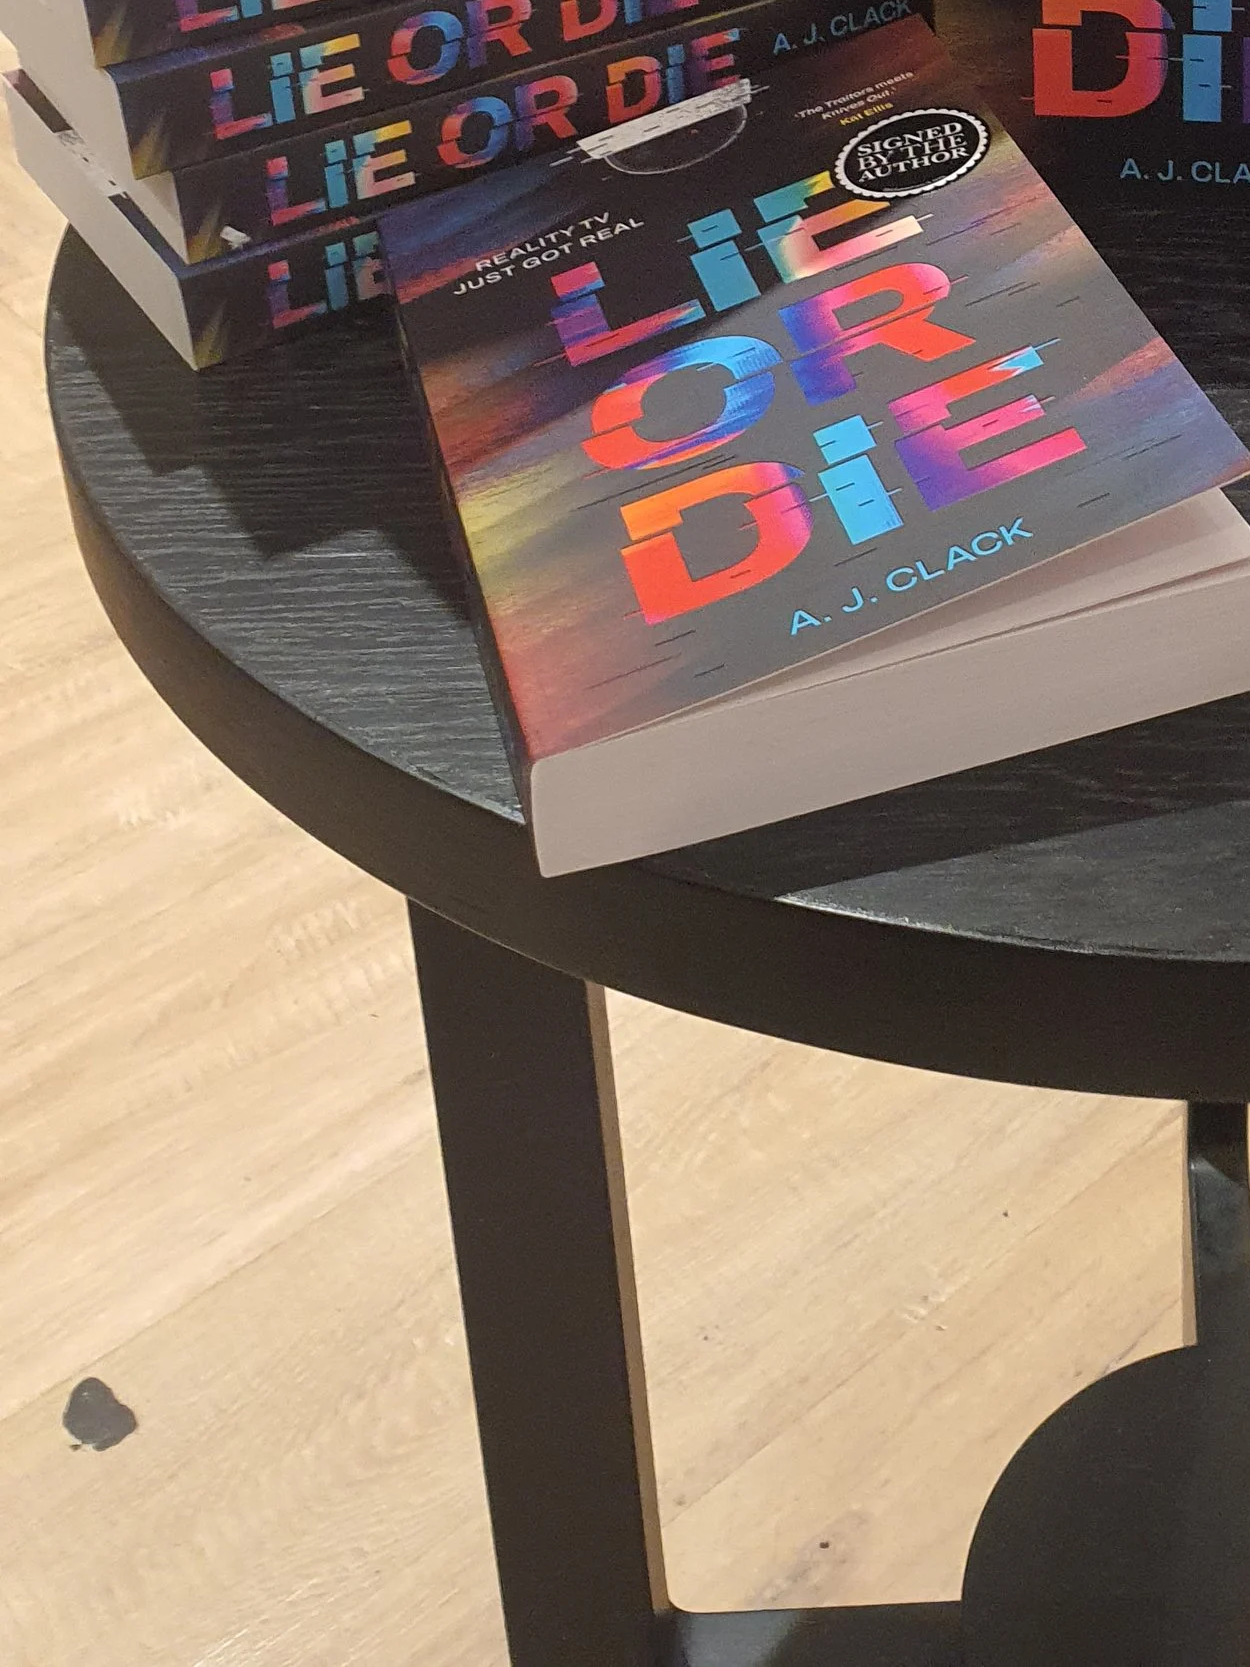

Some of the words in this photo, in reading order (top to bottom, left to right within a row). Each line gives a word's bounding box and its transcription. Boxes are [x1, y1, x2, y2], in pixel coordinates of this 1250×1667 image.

[857, 121, 963, 158] SIGNED
[858, 150, 896, 172] BY
[901, 133, 968, 159] THE
[858, 146, 970, 183] AUTHOR
[1120, 158, 1149, 180] A.
[1157, 160, 1182, 182] J.
[453, 266, 516, 296] JUST
[522, 242, 574, 269] GOT
[579, 218, 645, 248] REAL
[475, 226, 575, 272] REALITY
[578, 212, 610, 230] TV
[581, 262, 977, 471] OR
[789, 609, 832, 636] A.
[841, 586, 879, 614] J.
[886, 517, 1034, 595] CLACK
